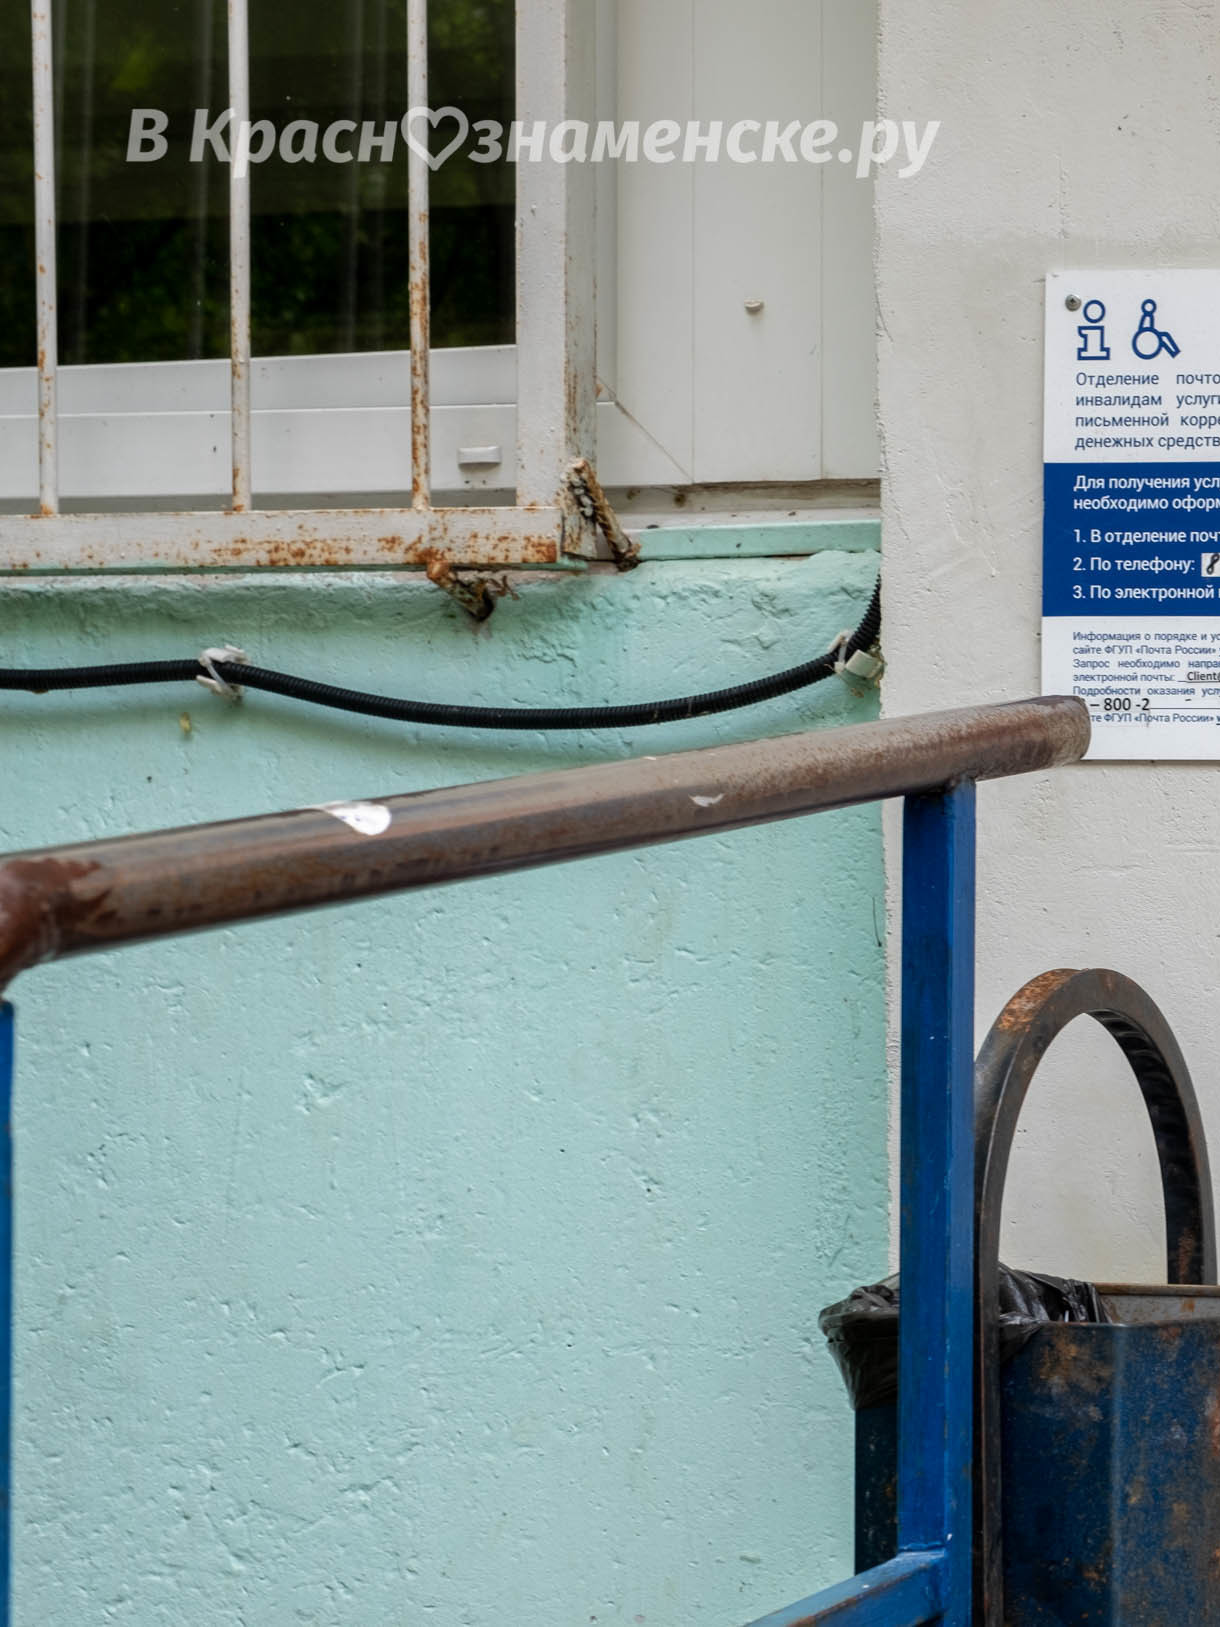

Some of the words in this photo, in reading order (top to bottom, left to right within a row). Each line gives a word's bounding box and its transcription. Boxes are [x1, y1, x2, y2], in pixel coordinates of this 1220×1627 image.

[1075, 371, 1160, 389] Отделение
[1075, 395, 1163, 409] инвалидам
[1075, 412, 1170, 428] письменной
[1074, 436, 1154, 451] денежных
[1072, 474, 1106, 493] Для
[1108, 477, 1191, 493] получения
[1073, 494, 1169, 513] необходимо
[1073, 528, 1087, 543] 1.
[1090, 528, 1102, 543] В
[1104, 531, 1187, 546] отделение
[1072, 556, 1087, 571] 2.
[1090, 556, 1112, 571] По
[1114, 555, 1196, 575] телефону:
[1072, 584, 1086, 599] 3.
[1089, 584, 1112, 599] По
[1114, 584, 1215, 603] электронной
[1072, 631, 1142, 643] Информация
[1143, 633, 1152, 641] о
[1153, 633, 1198, 643] порядке
[1200, 633, 1208, 641] и
[1072, 644, 1103, 655] сайте
[1103, 644, 1133, 655] ФГУП
[1135, 644, 1172, 655] «Почта
[1174, 644, 1217, 655] России»
[1072, 658, 1111, 671] Запрос
[1117, 658, 1181, 670] необходимо
[1072, 671, 1139, 684] электронной
[1139, 674, 1176, 682] почты:
[1072, 685, 1142, 699] Подробности
[1146, 686, 1197, 698] оказания
[1103, 697, 1133, 712] 800
[1103, 712, 1132, 723] ФГУП
[1133, 712, 1171, 724] «Почта
[1172, 712, 1215, 723] России»
